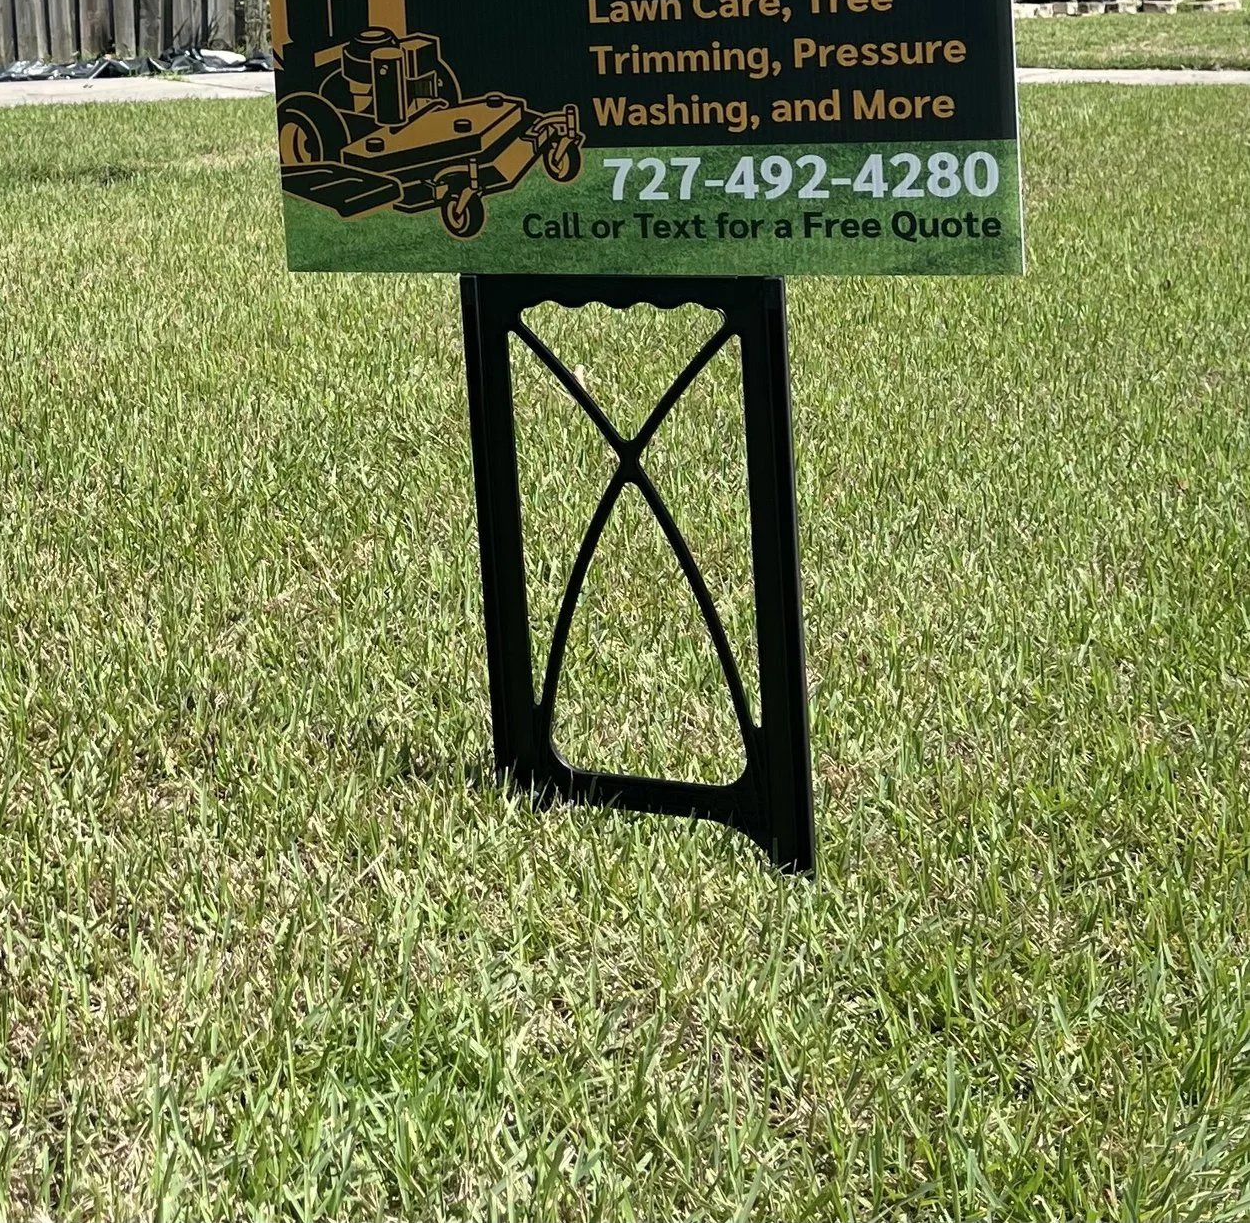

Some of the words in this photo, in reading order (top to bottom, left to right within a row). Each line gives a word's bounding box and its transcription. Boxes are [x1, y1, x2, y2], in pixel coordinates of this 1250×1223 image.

[589, 42, 780, 79] Trimming,
[794, 37, 966, 68] Pressure
[593, 94, 759, 132] Washing,
[772, 89, 840, 123] and
[853, 90, 954, 121] More
[603, 152, 999, 200] 727-492-4280
[523, 212, 582, 239] Call
[591, 219, 625, 239] or
[635, 213, 707, 239] Text
[716, 211, 764, 239] for
[773, 219, 793, 239] a
[804, 212, 881, 239] Free
[892, 211, 1001, 241] Quote
